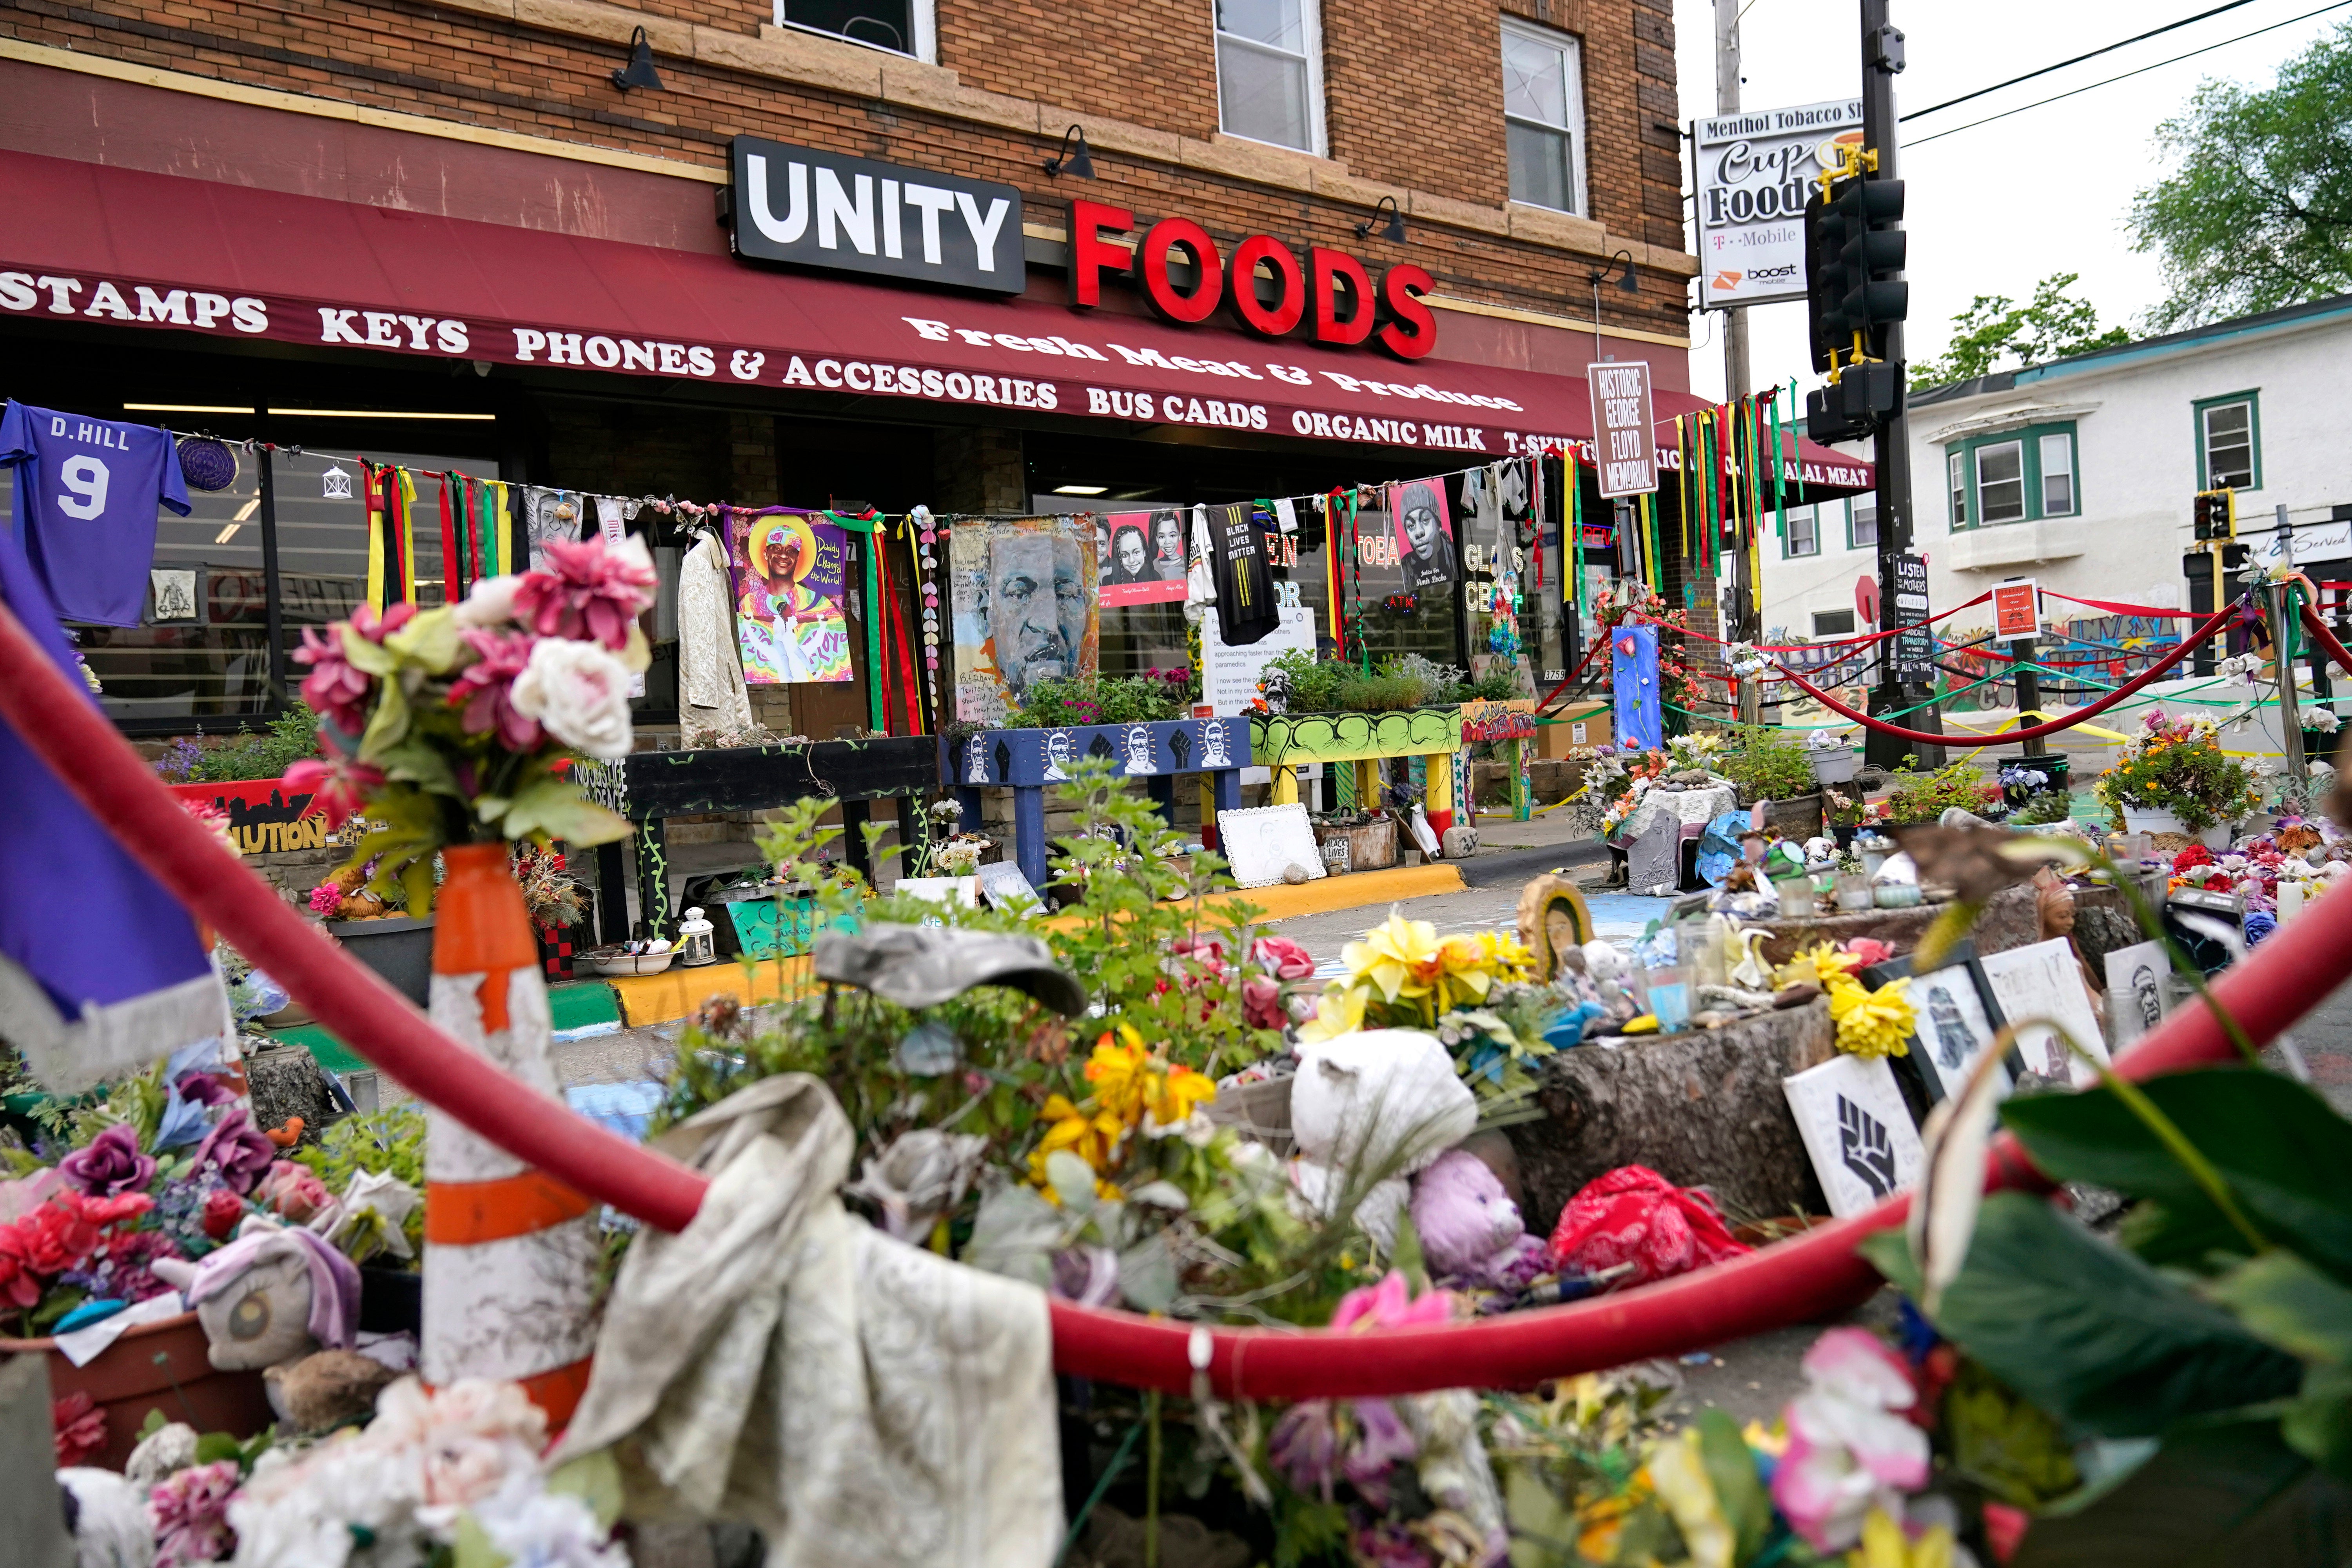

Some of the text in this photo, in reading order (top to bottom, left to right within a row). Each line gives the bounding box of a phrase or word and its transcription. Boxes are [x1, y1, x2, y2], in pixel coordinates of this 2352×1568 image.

[1707, 103, 1864, 138] Menthol Tobacco Sh
[1717, 140, 1815, 185] Cup
[746, 154, 1438, 358] UNITY FOODS
[1748, 263, 1797, 279] boost
[1759, 277, 1786, 286] mobile
[901, 317, 1524, 413] Fresh Meat & Produce
[0, 272, 269, 333] STAMPS
[318, 308, 469, 354] KEYS
[512, 328, 715, 377] PHONES
[730, 350, 765, 380] &
[782, 356, 1058, 410] ACCESSORIES
[1088, 387, 1154, 419] BUS
[1163, 396, 1268, 430] CARDS
[1292, 410, 1418, 445] ORGANIC
[1422, 423, 1486, 452] MILK
[1826, 466, 1868, 486] MEAT
[1598, 368, 1642, 399] HISTORIC
[1605, 397, 1641, 428] GEORGE
[51, 416, 129, 451] D.HILL
[1610, 430, 1641, 460] FLOYD
[1606, 459, 1652, 492] MEMORIAL
[57, 454, 110, 521] 9
[1226, 523, 1249, 536] BLACK
[816, 535, 840, 559] Daddy
[1229, 535, 1250, 548] LIVES
[2294, 528, 2350, 553] Served
[1228, 546, 1256, 560] MATTER
[1465, 544, 1524, 573] GLS
[816, 553, 842, 574] Changed
[1898, 561, 1925, 578] LISTEN
[810, 571, 842, 585] the World!
[1416, 573, 1447, 587] Amir Locke
[1903, 579, 1926, 592] MOTHERS
[1390, 595, 1413, 608] ATM
[1901, 636, 1929, 646] TRANSFORM
[1947, 633, 1965, 642] BLACK
[1214, 651, 1247, 660] approaching
[1546, 670, 1565, 680] 3759
[1919, 662, 1933, 672] TIME
[1474, 702, 1508, 722] GANG
[1484, 715, 1536, 736] LIVES MATTER
[1327, 838, 1346, 848] BLACK
[1328, 848, 1345, 857] LIVES
